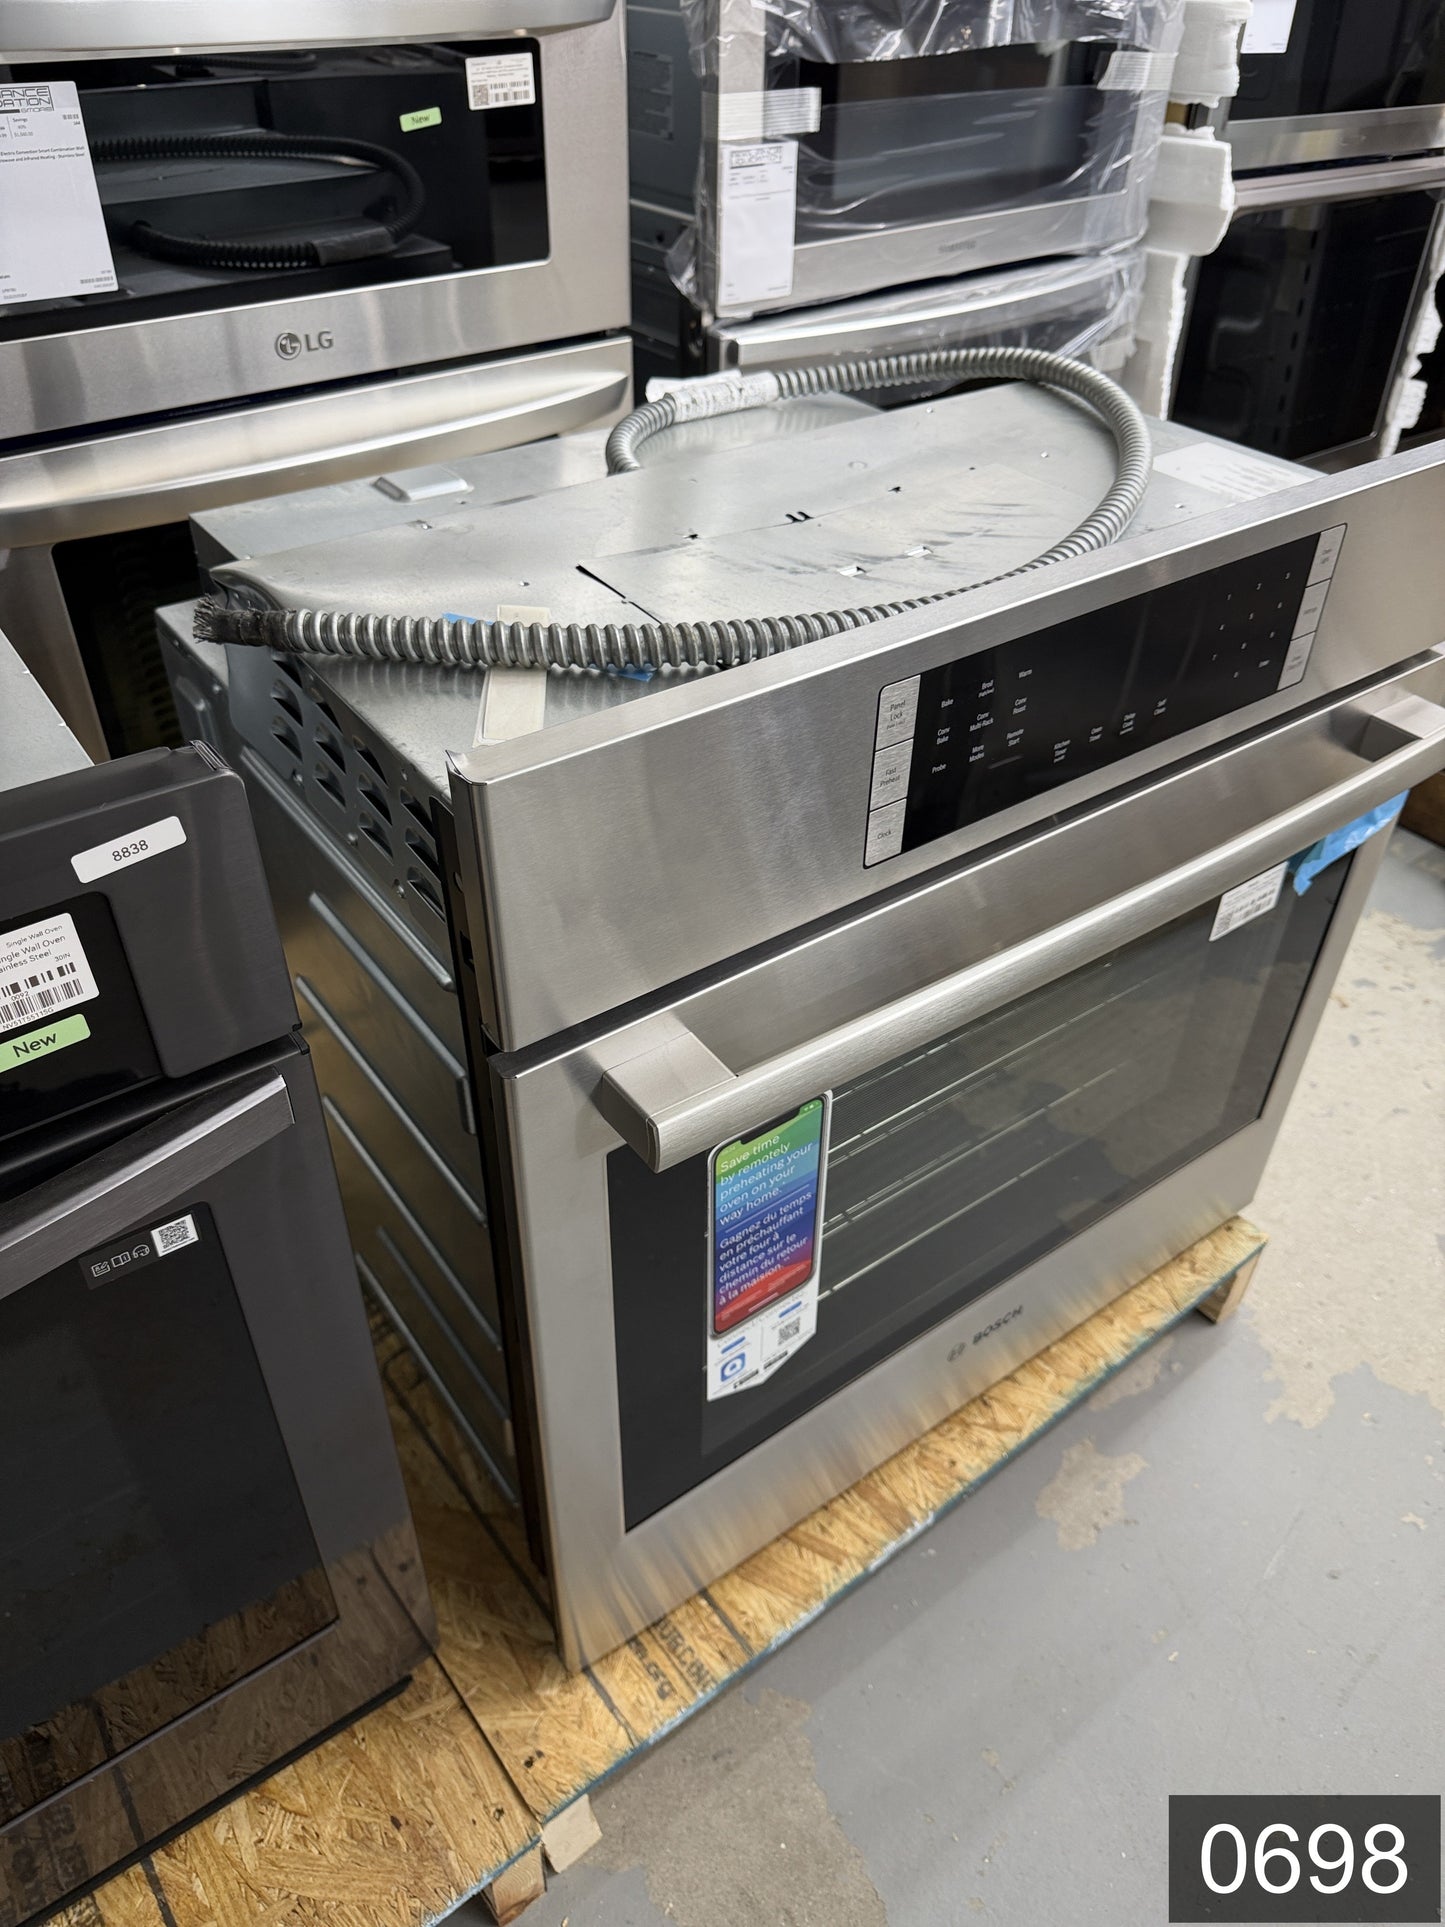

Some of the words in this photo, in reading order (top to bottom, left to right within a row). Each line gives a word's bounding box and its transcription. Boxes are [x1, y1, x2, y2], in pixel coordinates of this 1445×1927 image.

[0, 98, 51, 107] ATION
[304, 331, 334, 352] LG
[1019, 669, 1032, 678] Warm
[981, 680, 993, 690] Broil
[889, 699, 906, 712] Panel
[941, 699, 954, 708] Bake
[1014, 697, 1028, 706] Conv
[890, 711, 903, 721] Lock
[976, 712, 989, 721] Conv
[938, 727, 951, 736] Conv
[972, 744, 985, 754] More
[969, 752, 985, 762] Modes
[885, 768, 897, 777] Fast
[932, 764, 947, 774] Probe
[880, 775, 900, 788] Preheat
[877, 829, 891, 840] Clock
[112, 839, 149, 861] 8838
[6, 936, 27, 948] Single
[28, 930, 44, 940] Wall
[45, 925, 62, 935] Oven
[21, 942, 41, 954] Wall
[42, 935, 66, 947] Oven
[29, 948, 52, 962] Steel
[54, 952, 71, 962] 30IN
[10, 990, 29, 1001] 0092
[12, 1033, 57, 1058] New
[720, 1151, 750, 1173] Save
[753, 1135, 780, 1155] time
[720, 1171, 735, 1187] by
[738, 1142, 790, 1176] remotely
[720, 1158, 785, 1201] preheating
[785, 1143, 813, 1164] your
[720, 1194, 748, 1213] oven
[751, 1182, 767, 1195] on
[769, 1165, 795, 1188] your
[720, 1207, 743, 1226] way
[720, 1220, 760, 1249] Gagnez
[763, 1210, 777, 1224] du
[779, 1191, 812, 1213] temps
[719, 1248, 734, 1261] en
[736, 1207, 804, 1253] préchauffant
[719, 1252, 747, 1272] votre
[749, 1237, 771, 1254] four
[773, 1231, 780, 1241] à
[719, 1252, 765, 1283] distance
[767, 1240, 785, 1255] sur
[786, 1233, 797, 1244] le
[719, 1266, 759, 1294] chemin
[760, 1257, 774, 1269] du
[776, 1236, 808, 1260] retour
[719, 1295, 726, 1305] à
[728, 1289, 739, 1300] la
[972, 1304, 1023, 1345] BOSCH
